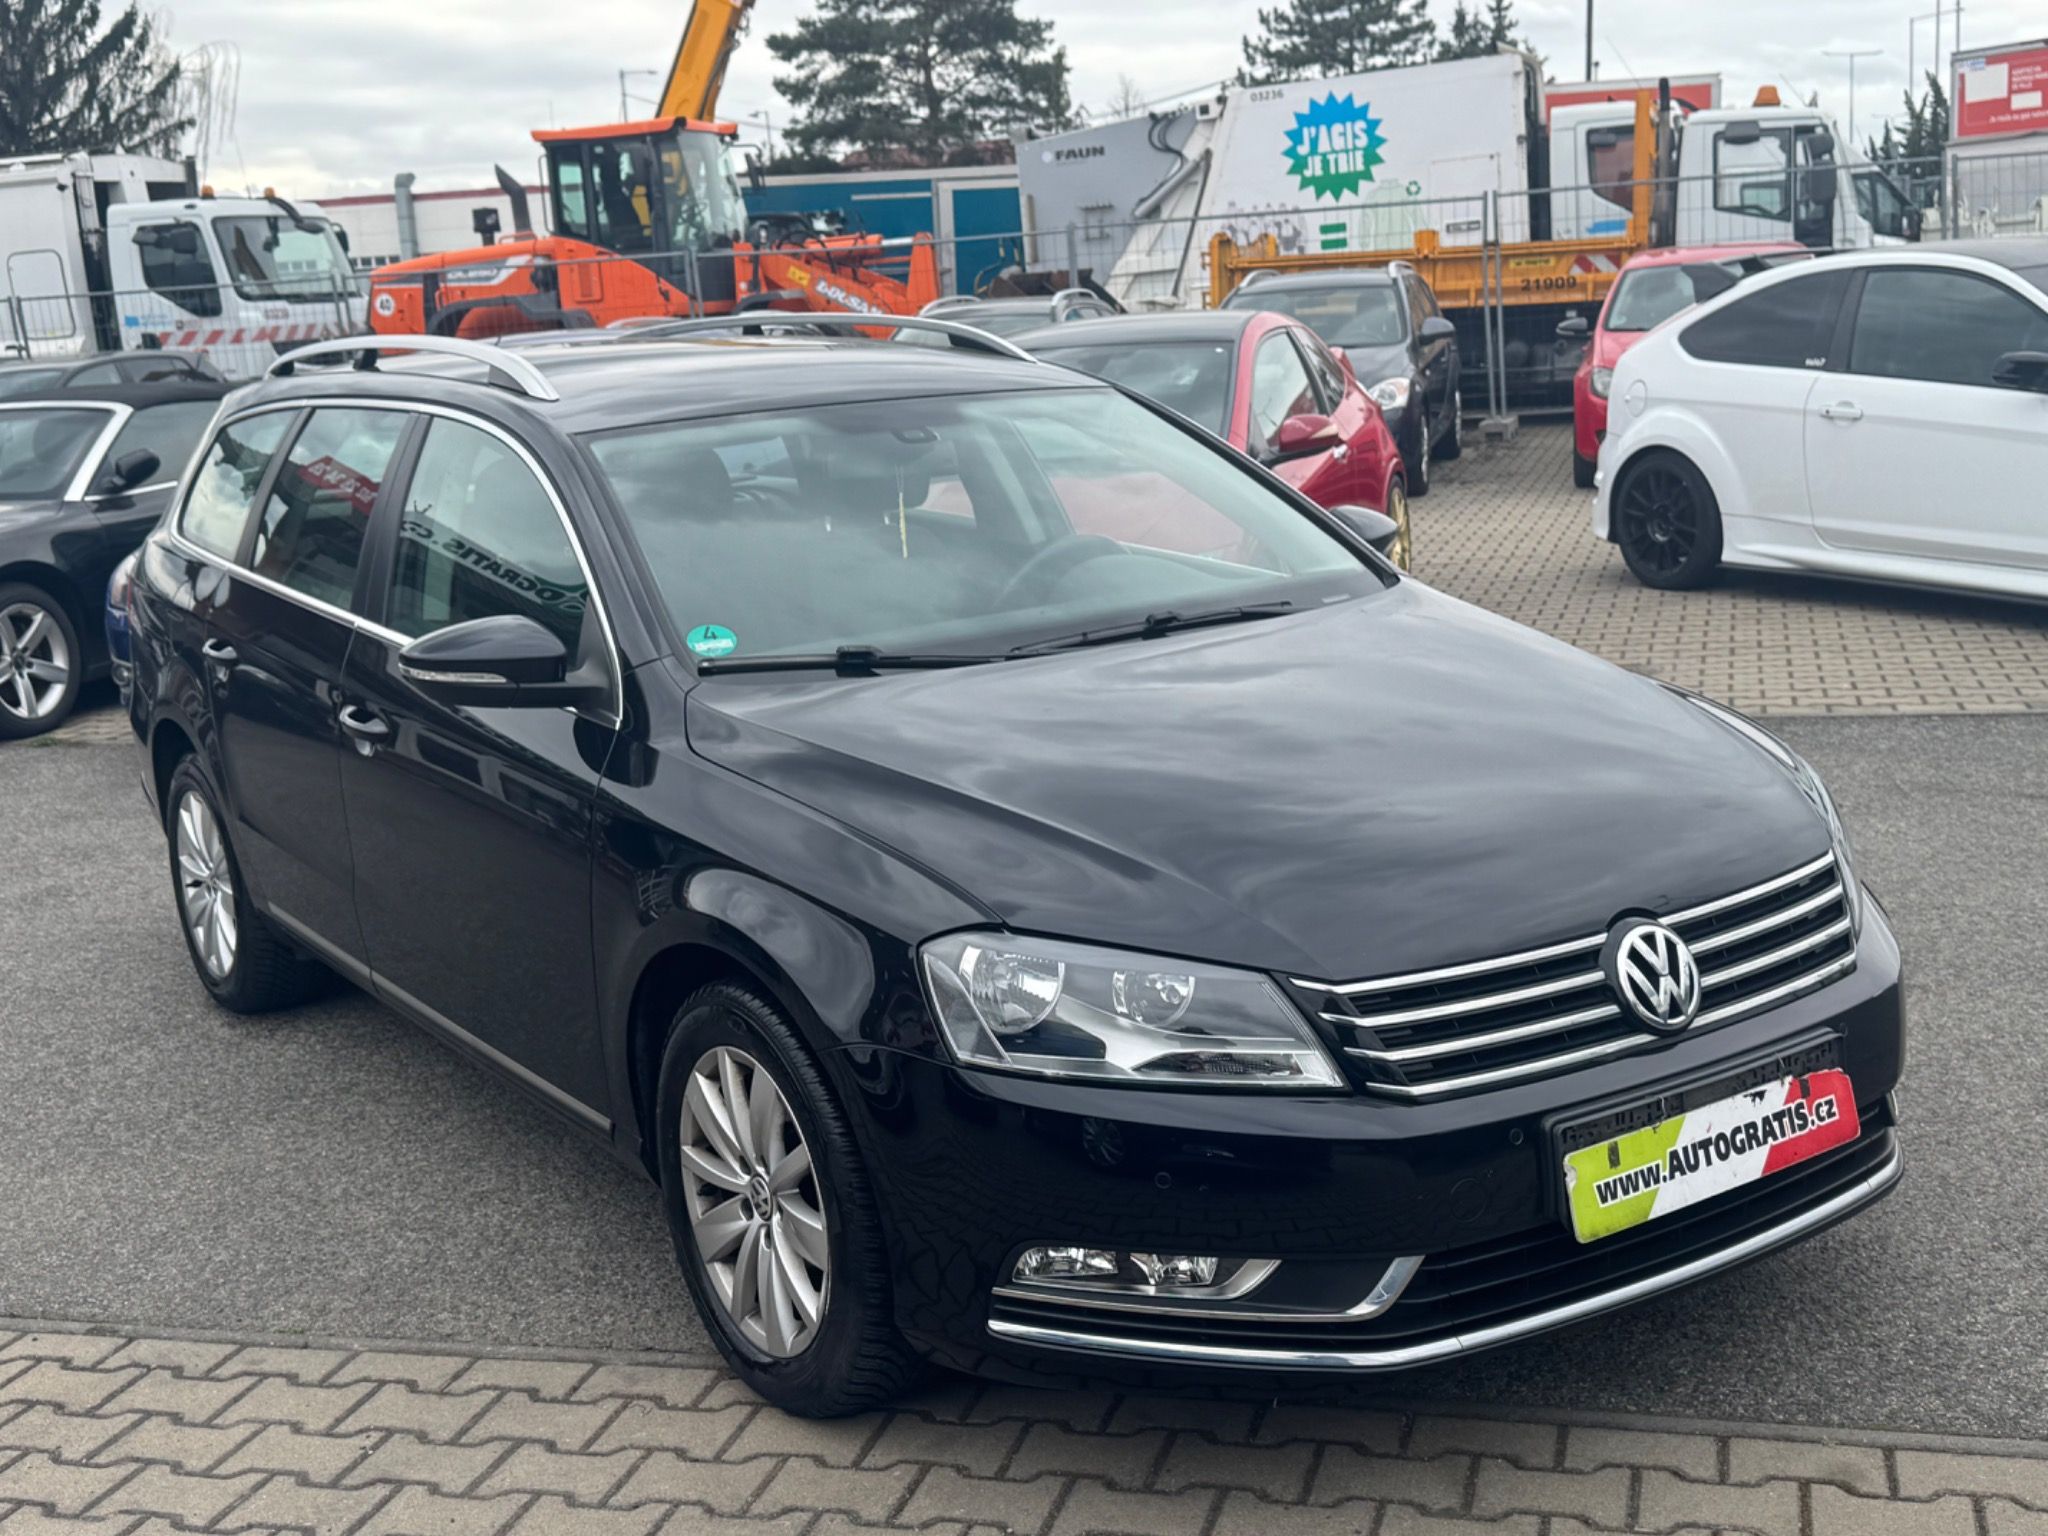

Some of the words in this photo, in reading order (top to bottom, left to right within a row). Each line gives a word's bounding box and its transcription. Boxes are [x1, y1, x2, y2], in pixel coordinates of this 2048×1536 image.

[1296, 120, 1369, 155] J'AGIS
[1055, 145, 1105, 160] FAUN
[1303, 155, 1324, 177] JE
